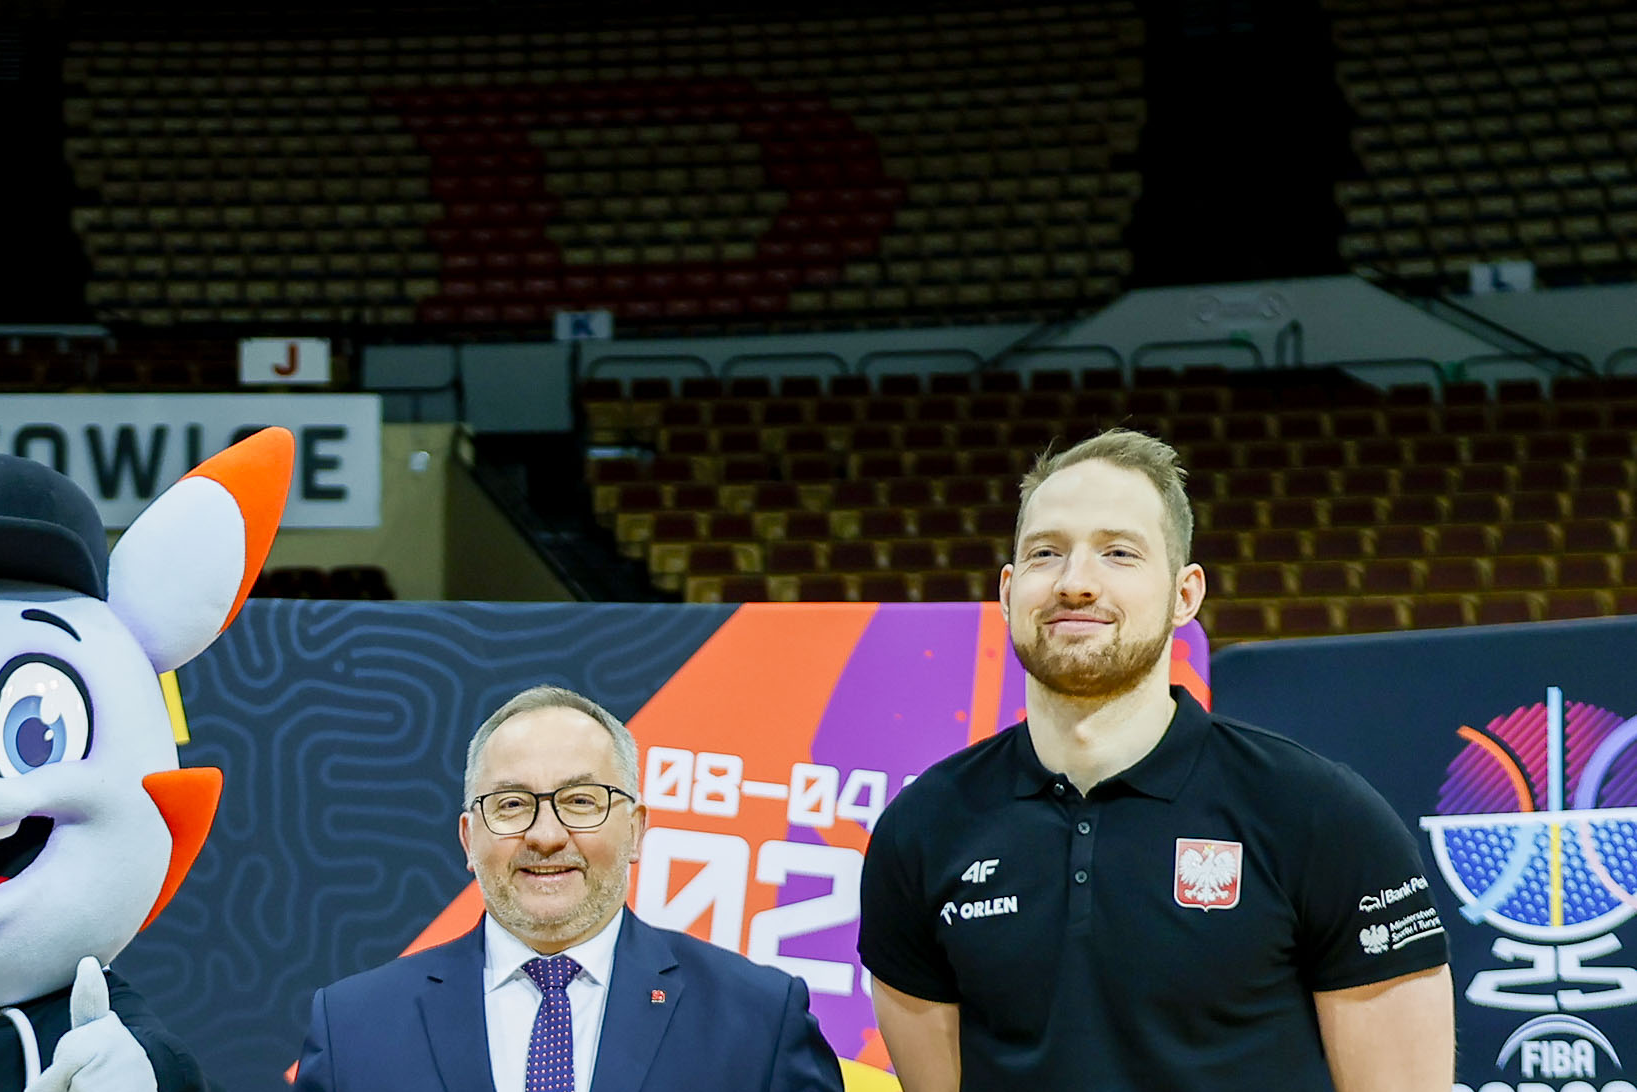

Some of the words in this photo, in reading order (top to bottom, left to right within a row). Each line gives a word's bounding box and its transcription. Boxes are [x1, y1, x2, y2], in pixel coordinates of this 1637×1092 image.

[271, 343, 299, 376] J
[635, 826, 872, 997] 02
[960, 896, 1018, 919] ORLEN
[1520, 1039, 1596, 1079] FIBA
